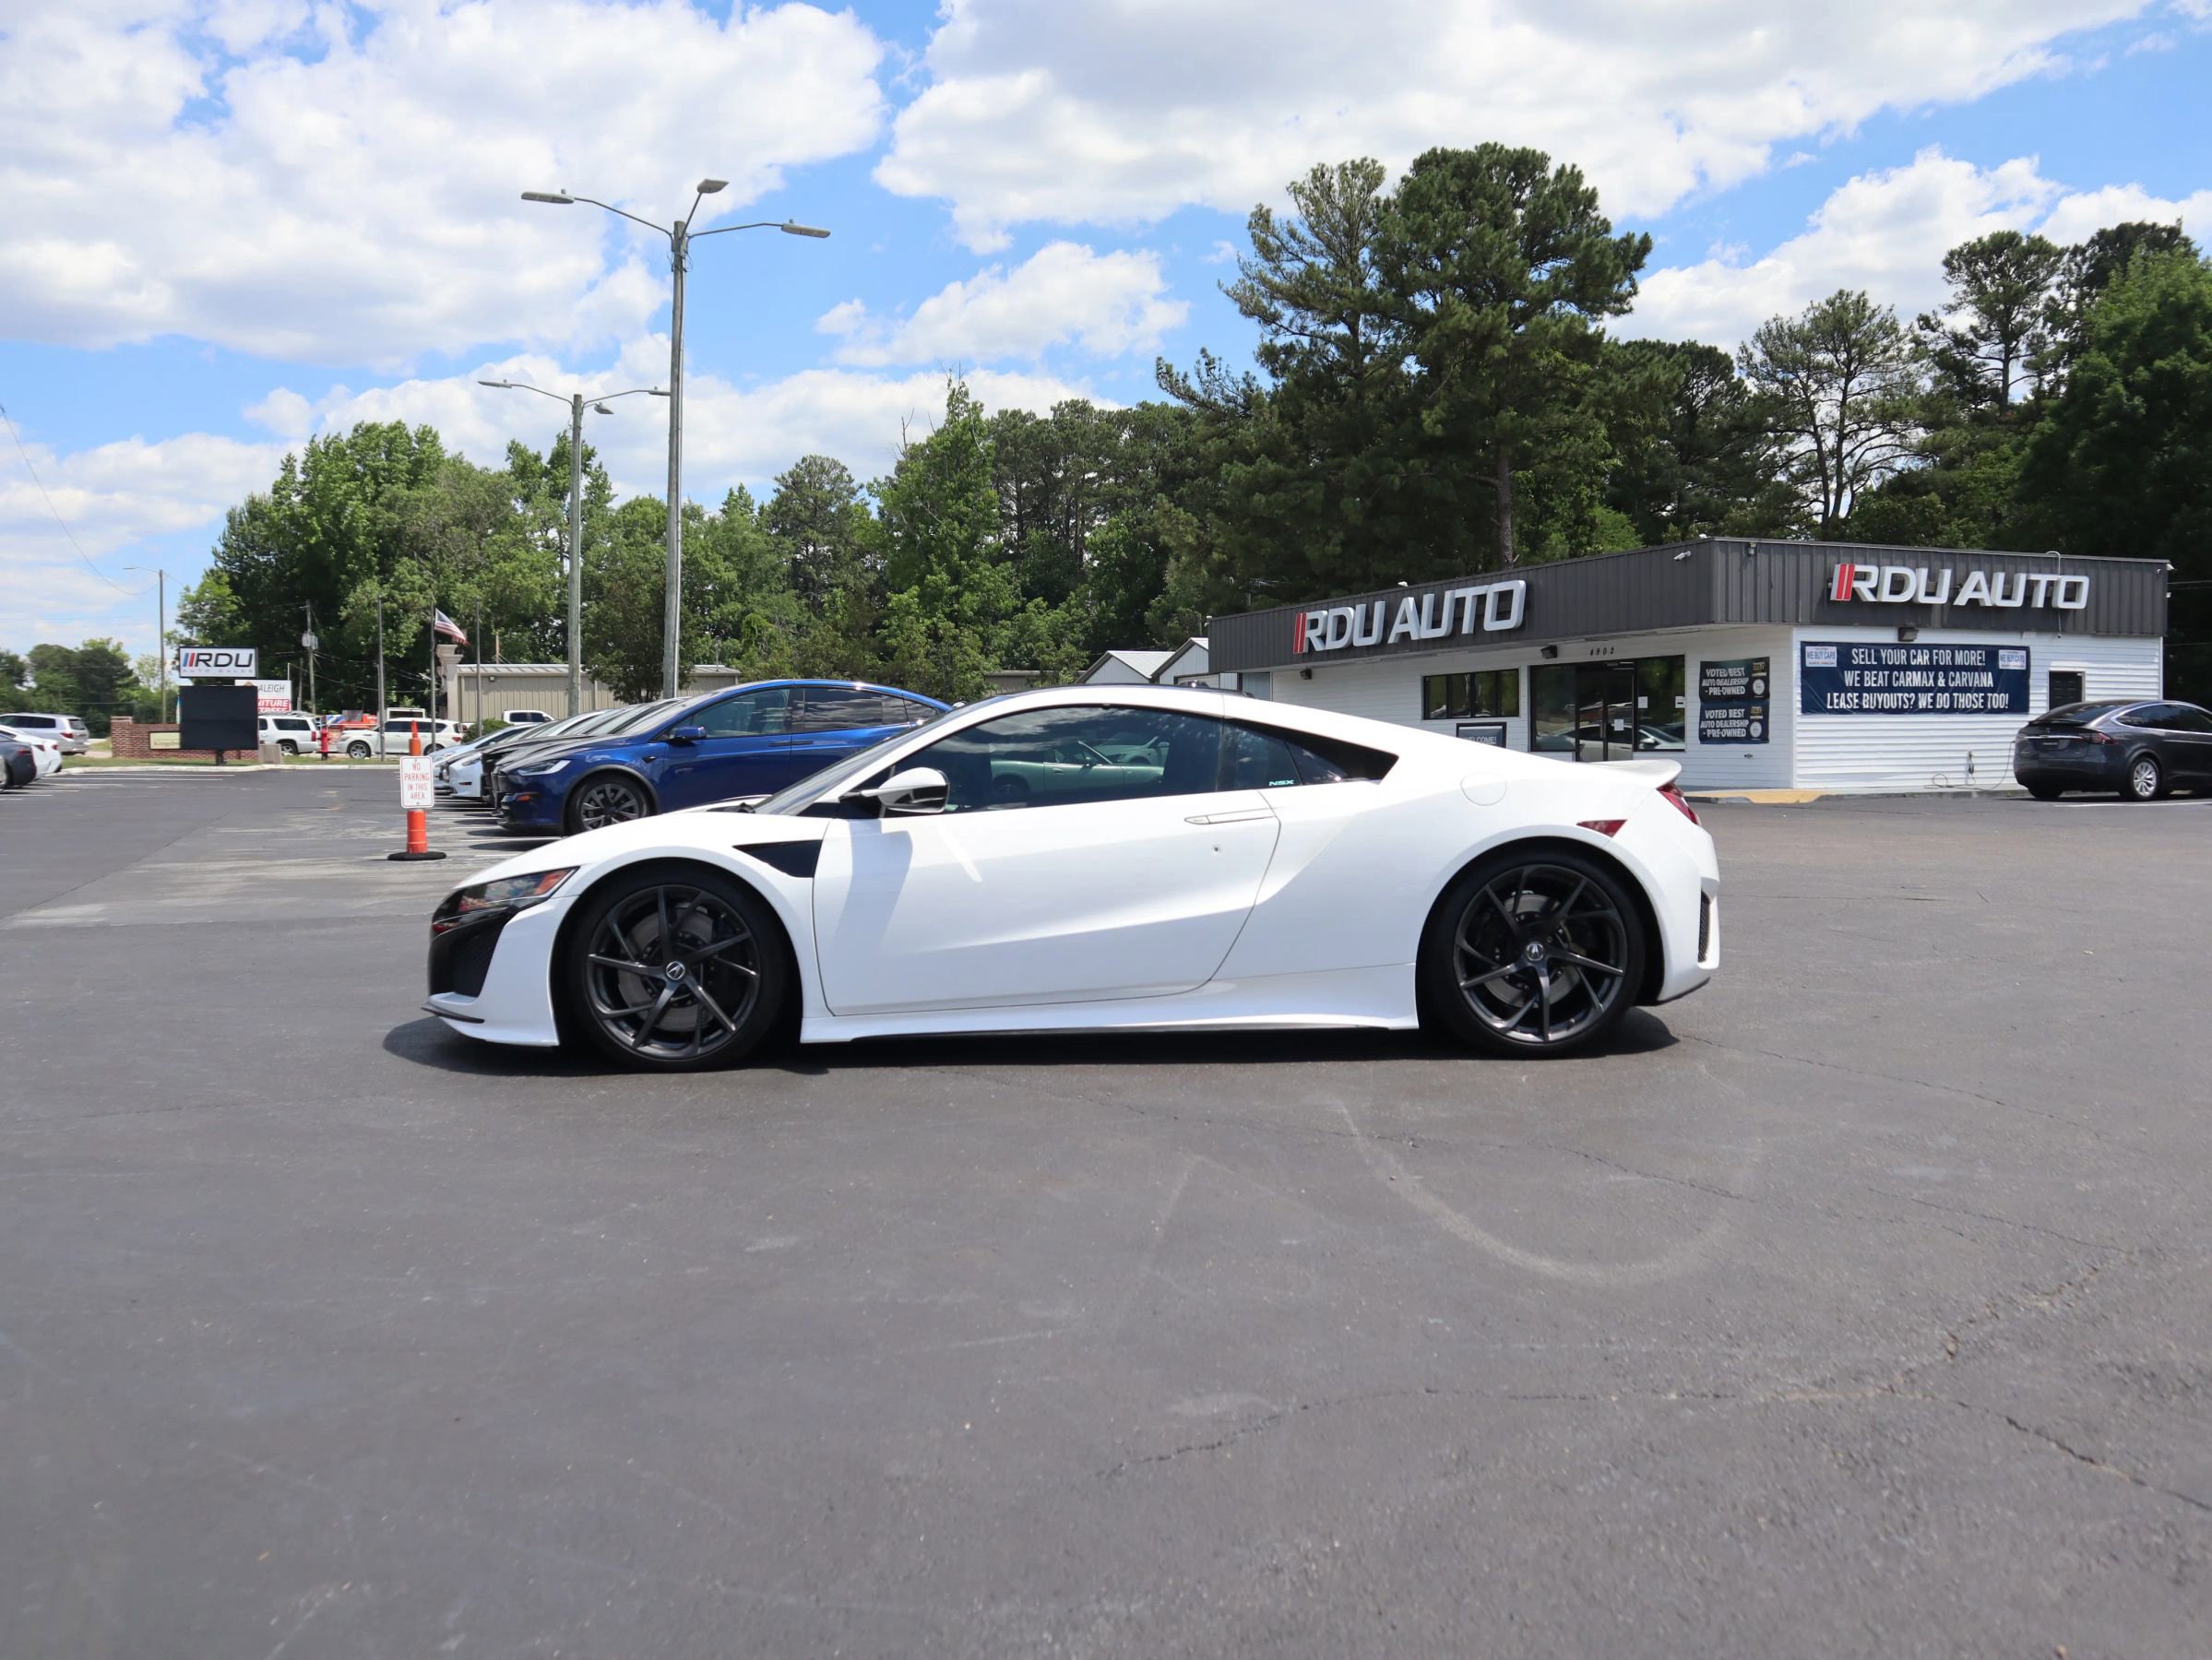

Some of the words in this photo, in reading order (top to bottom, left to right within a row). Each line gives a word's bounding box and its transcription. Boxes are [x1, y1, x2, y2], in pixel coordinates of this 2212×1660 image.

[1851, 564, 1951, 604] RDU
[1953, 571, 2089, 609] AUTO
[1305, 600, 1385, 652] RDU
[1387, 580, 1526, 644] AUTO
[1589, 646, 1614, 656] 4902
[195, 653, 253, 667] RDU
[1851, 648, 1877, 665] SELL
[1880, 649, 1907, 665] YOUR
[1910, 649, 1930, 665] CAR
[1933, 649, 1952, 665] FOR
[1955, 650, 1985, 666] MORE!
[1706, 668, 1728, 678] VOTED
[1729, 668, 1745, 677] BEST
[1702, 679, 1716, 687] AUTO
[1716, 678, 1749, 686] DEALERSHIP
[1844, 670, 1861, 687] WE
[1863, 670, 1889, 687] BEAT
[1892, 671, 1934, 687] CARMAX
[1937, 671, 1945, 687] &
[1948, 671, 1994, 688] CARVANA
[258, 683, 285, 693] ALEIGH
[1708, 686, 1746, 696] PRE-OWNED
[1826, 693, 1859, 709] LEASE
[1861, 693, 1916, 709] BUYOUTS?
[1918, 693, 1933, 709] WE
[1935, 693, 1950, 709] DO
[1953, 693, 1984, 709] THOSE
[1987, 694, 2009, 709] TOO!
[1705, 709, 1727, 719] VOTED
[1728, 708, 1745, 718] BEST
[1700, 720, 1715, 729] AUTO
[1716, 719, 1749, 728] DEALERSHIP
[1707, 728, 1746, 738] PRE-OWNED
[412, 762, 421, 771] NO
[404, 773, 430, 781] PARKING
[408, 783, 413, 791] IN
[415, 783, 428, 791] THIS
